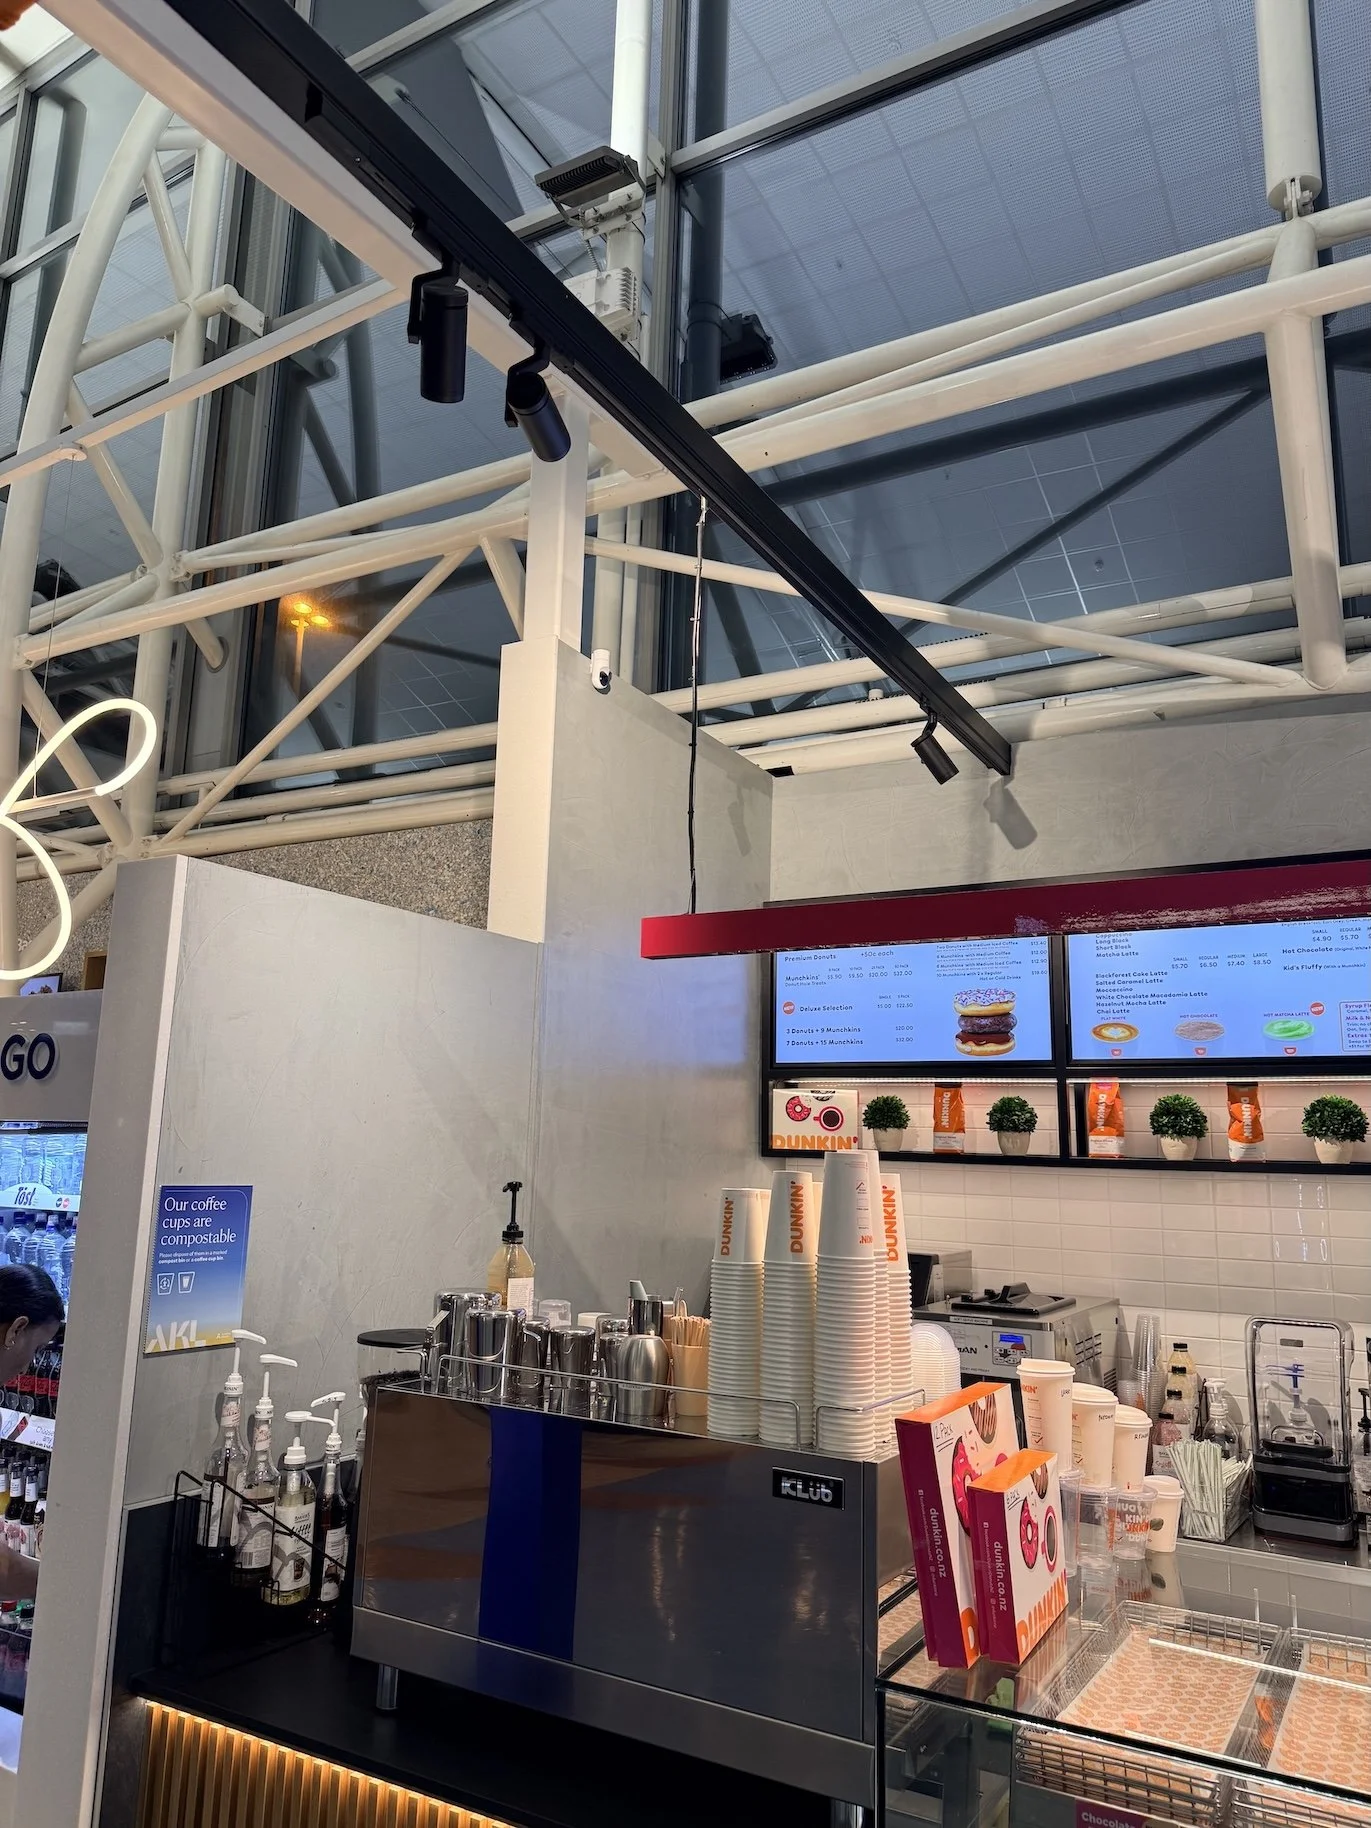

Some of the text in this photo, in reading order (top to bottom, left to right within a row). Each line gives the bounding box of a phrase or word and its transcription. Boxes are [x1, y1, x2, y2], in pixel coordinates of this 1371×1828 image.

[1, 1033, 55, 1080] GO
[771, 1134, 858, 1149] DUNKIN'
[162, 1216, 212, 1231] cups are
[164, 1195, 227, 1212] Our coffee
[720, 1197, 734, 1256] DUNKIN'
[790, 1180, 804, 1254] DUNKIN'
[882, 1185, 899, 1262] DUNKIN'
[161, 1228, 237, 1247] compostable
[149, 1319, 206, 1353] AKL
[930, 1508, 946, 1577] dunkin.co.nz
[994, 1541, 1006, 1611] dunkin.co.nz
[1017, 1568, 1067, 1662] DUNKIN'
